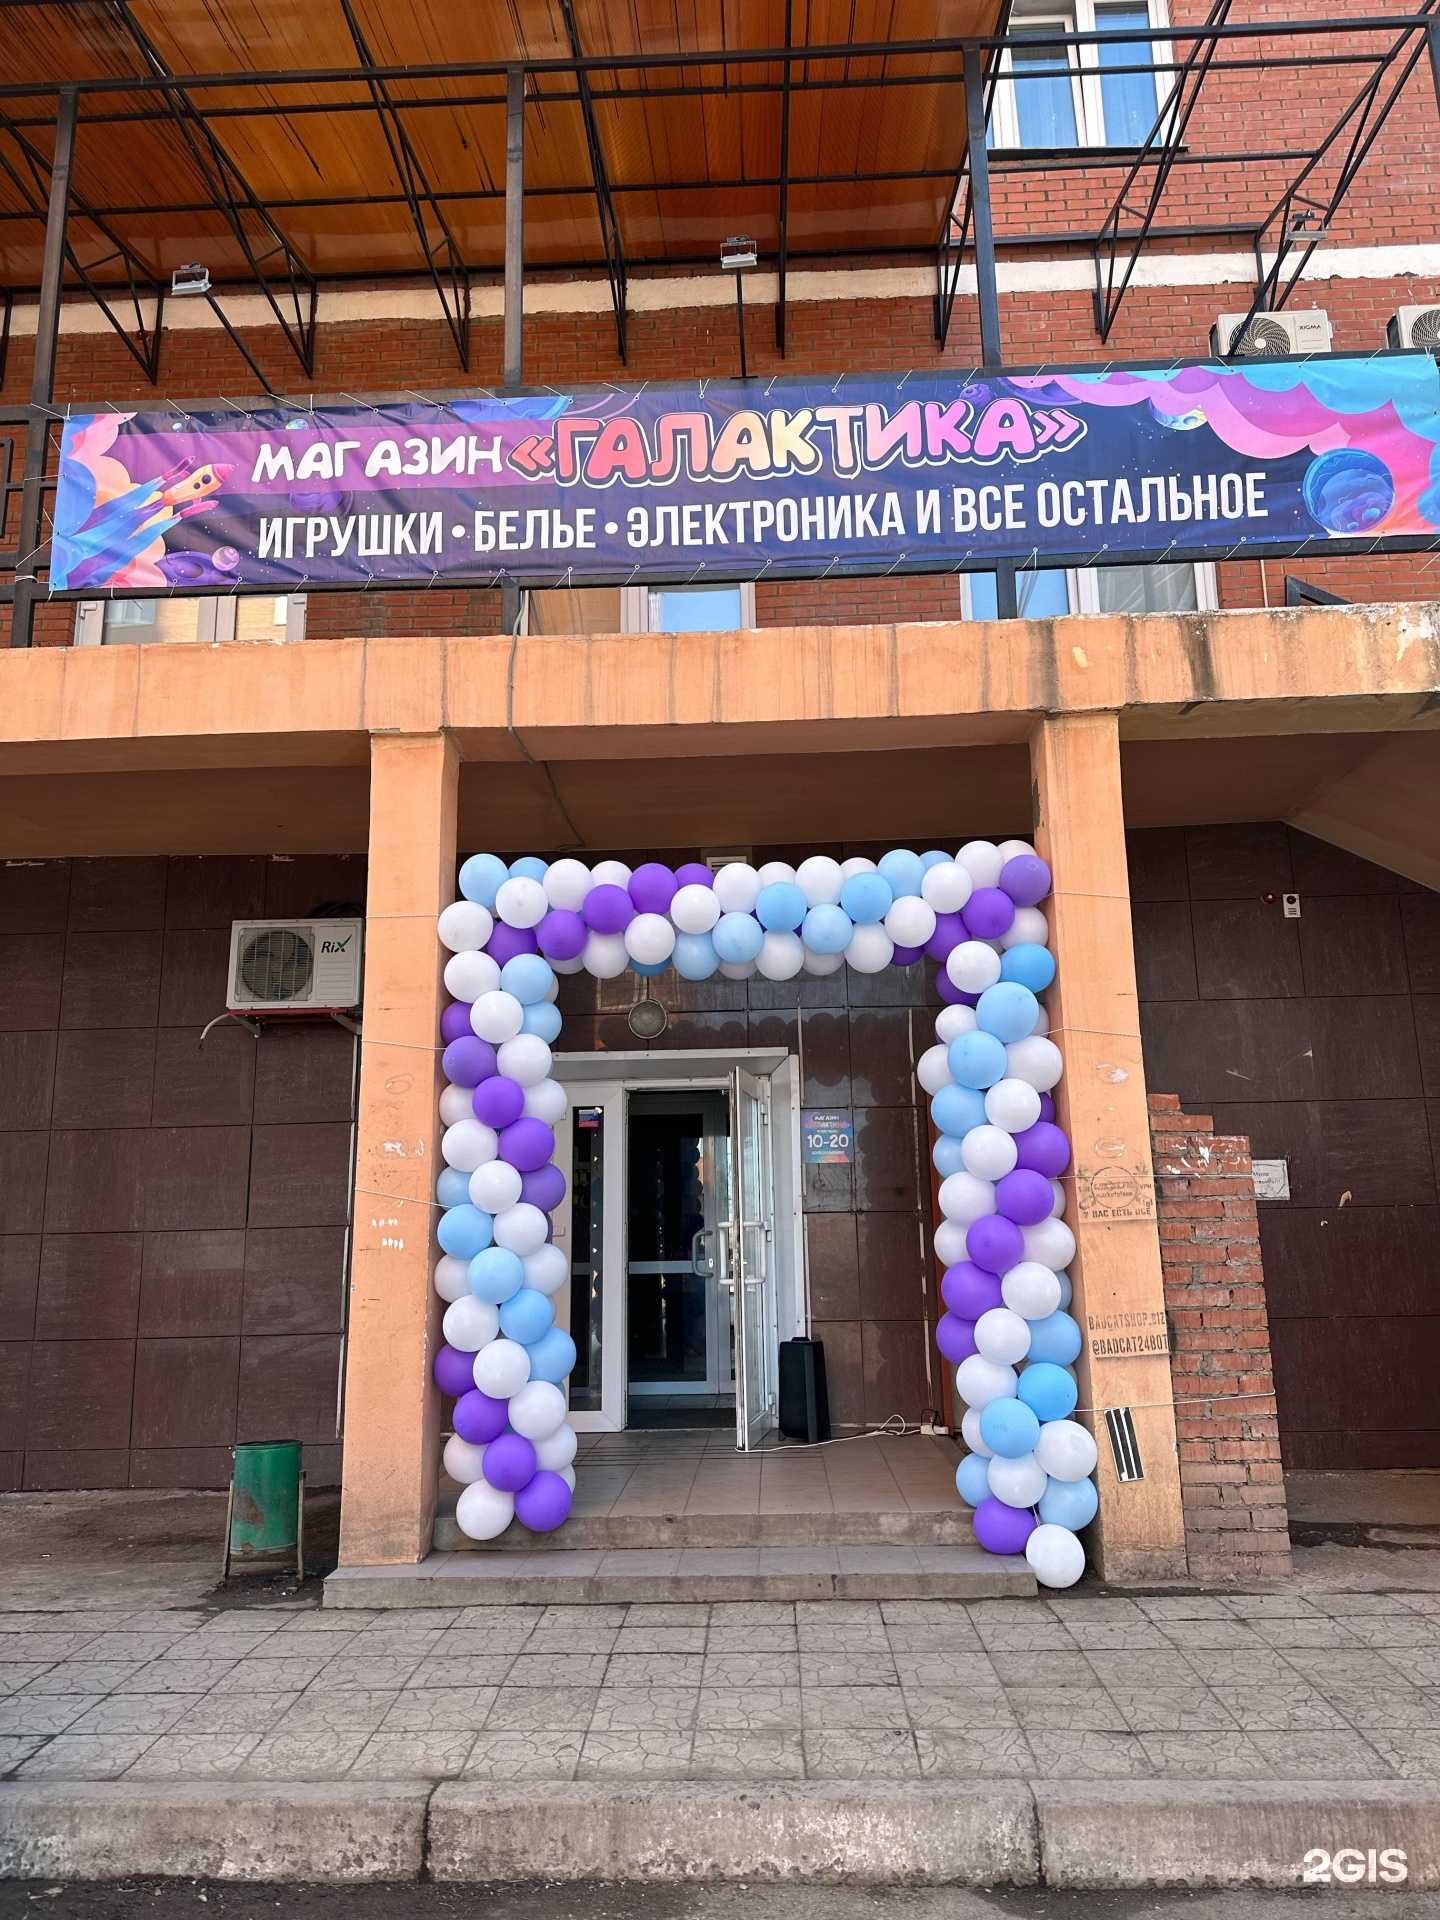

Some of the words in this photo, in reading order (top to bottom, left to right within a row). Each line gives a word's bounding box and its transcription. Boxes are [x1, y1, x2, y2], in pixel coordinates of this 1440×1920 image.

[251, 434, 503, 484] МАГАЗИН
[507, 397, 1088, 489] «ГАЛАКТИКА»
[257, 510, 444, 560] ИГРУШКИ
[473, 507, 597, 553] БЕЛЬЕ
[625, 490, 906, 548] ЭЛЕКТРОНИКА
[915, 487, 940, 535] И
[954, 483, 1027, 533] ВСЕ
[1037, 471, 1269, 528] ОСТАЛЬНОЕ
[807, 1133, 849, 1148] 10-20
[1092, 1333, 1168, 1355] @BADCAT24BOT
